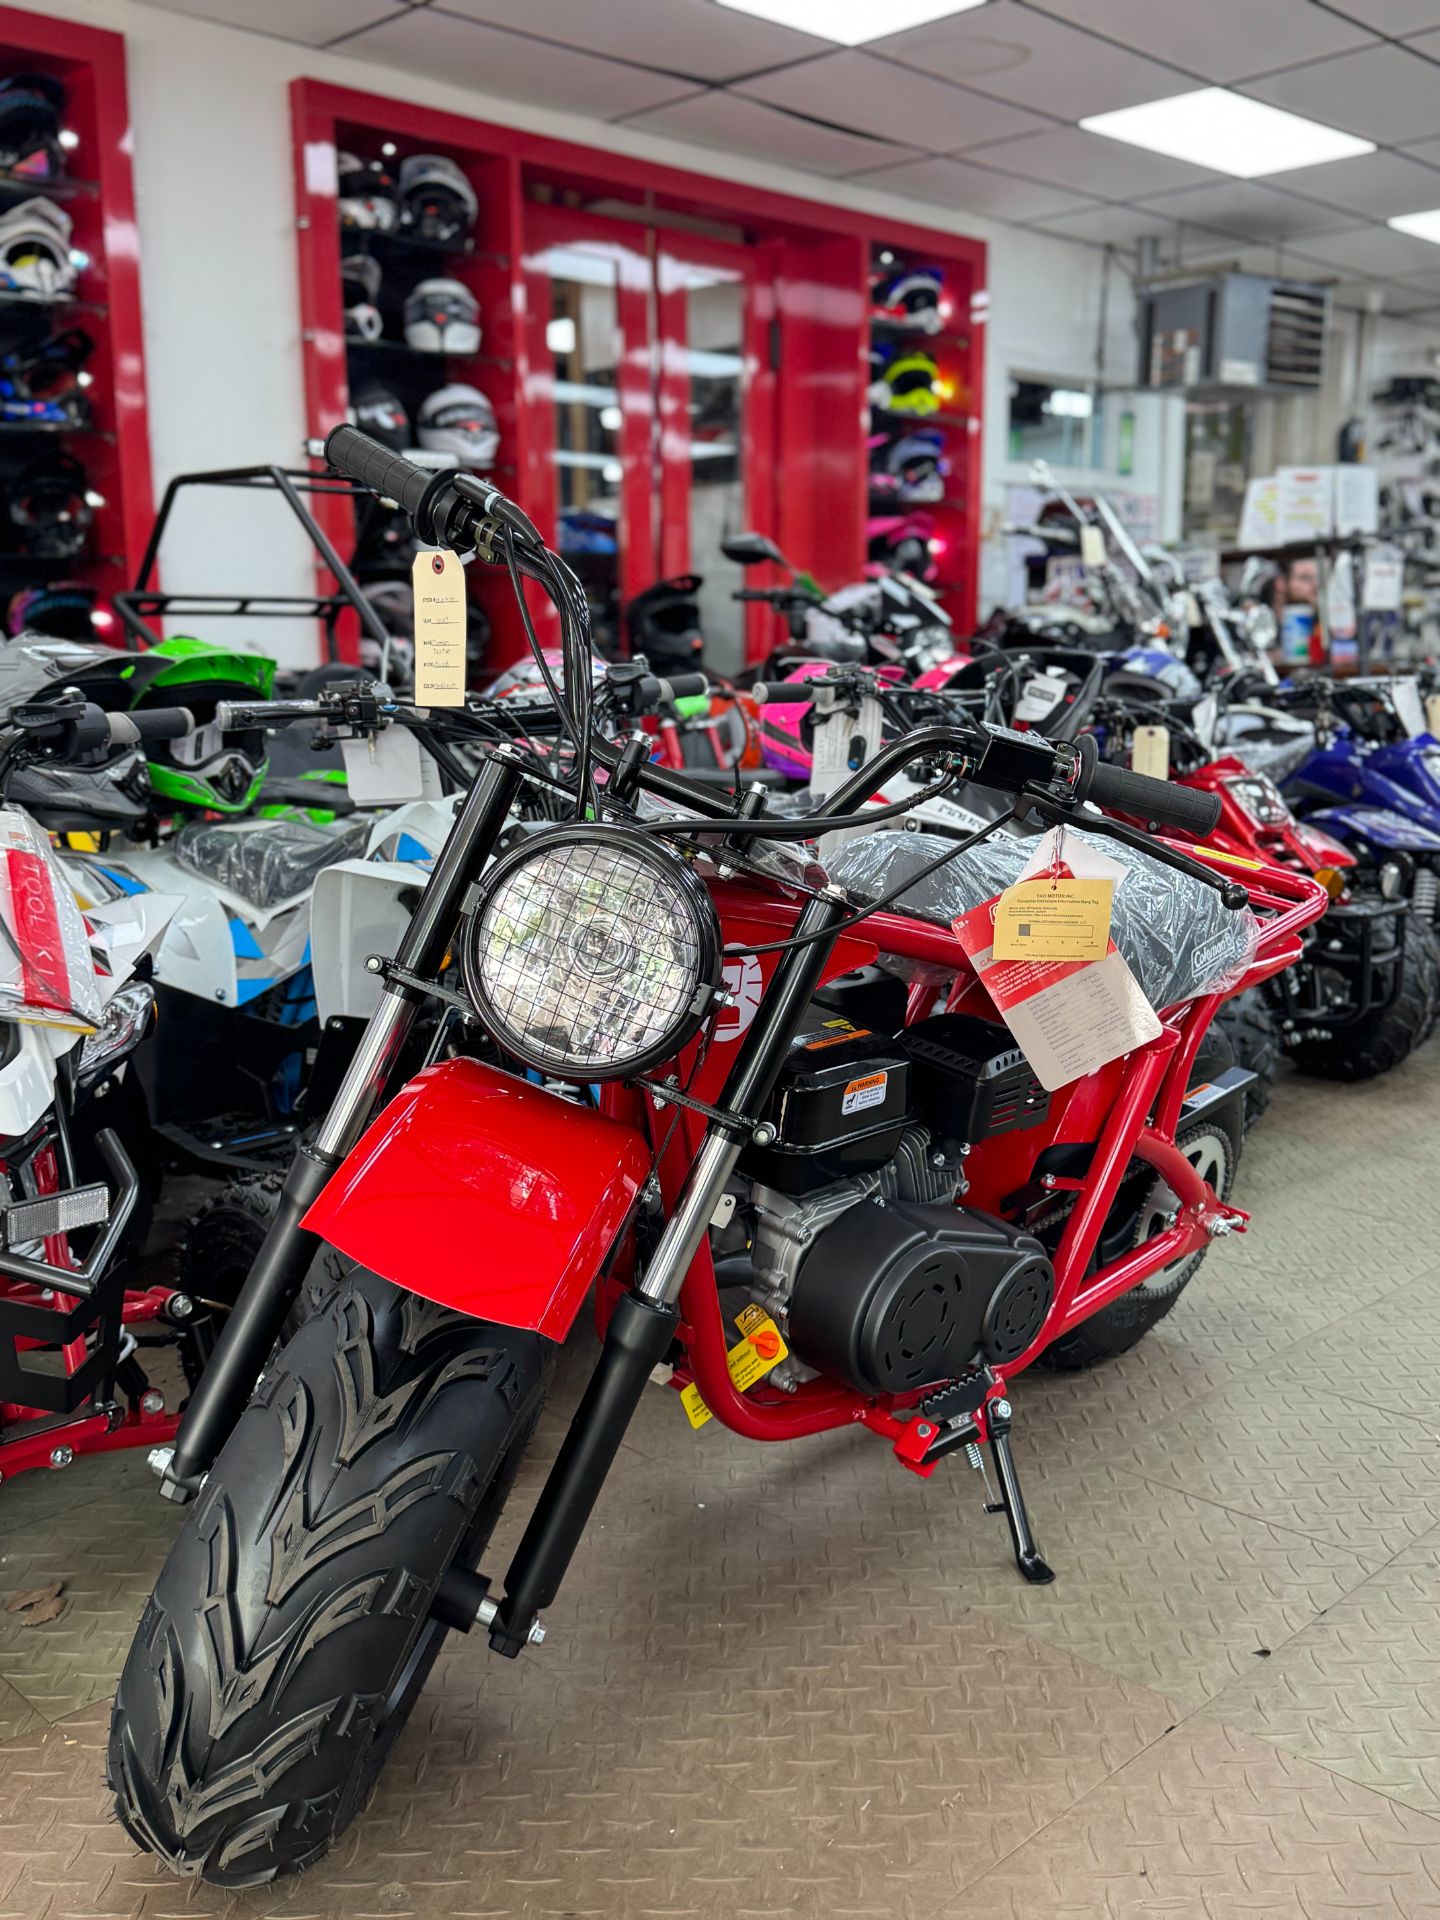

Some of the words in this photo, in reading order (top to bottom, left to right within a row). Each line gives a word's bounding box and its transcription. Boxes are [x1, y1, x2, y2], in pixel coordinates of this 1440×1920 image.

[24, 864, 48, 926] TOOL
[1194, 939, 1226, 968] Coleman
[858, 1078, 880, 1090] WARNING
